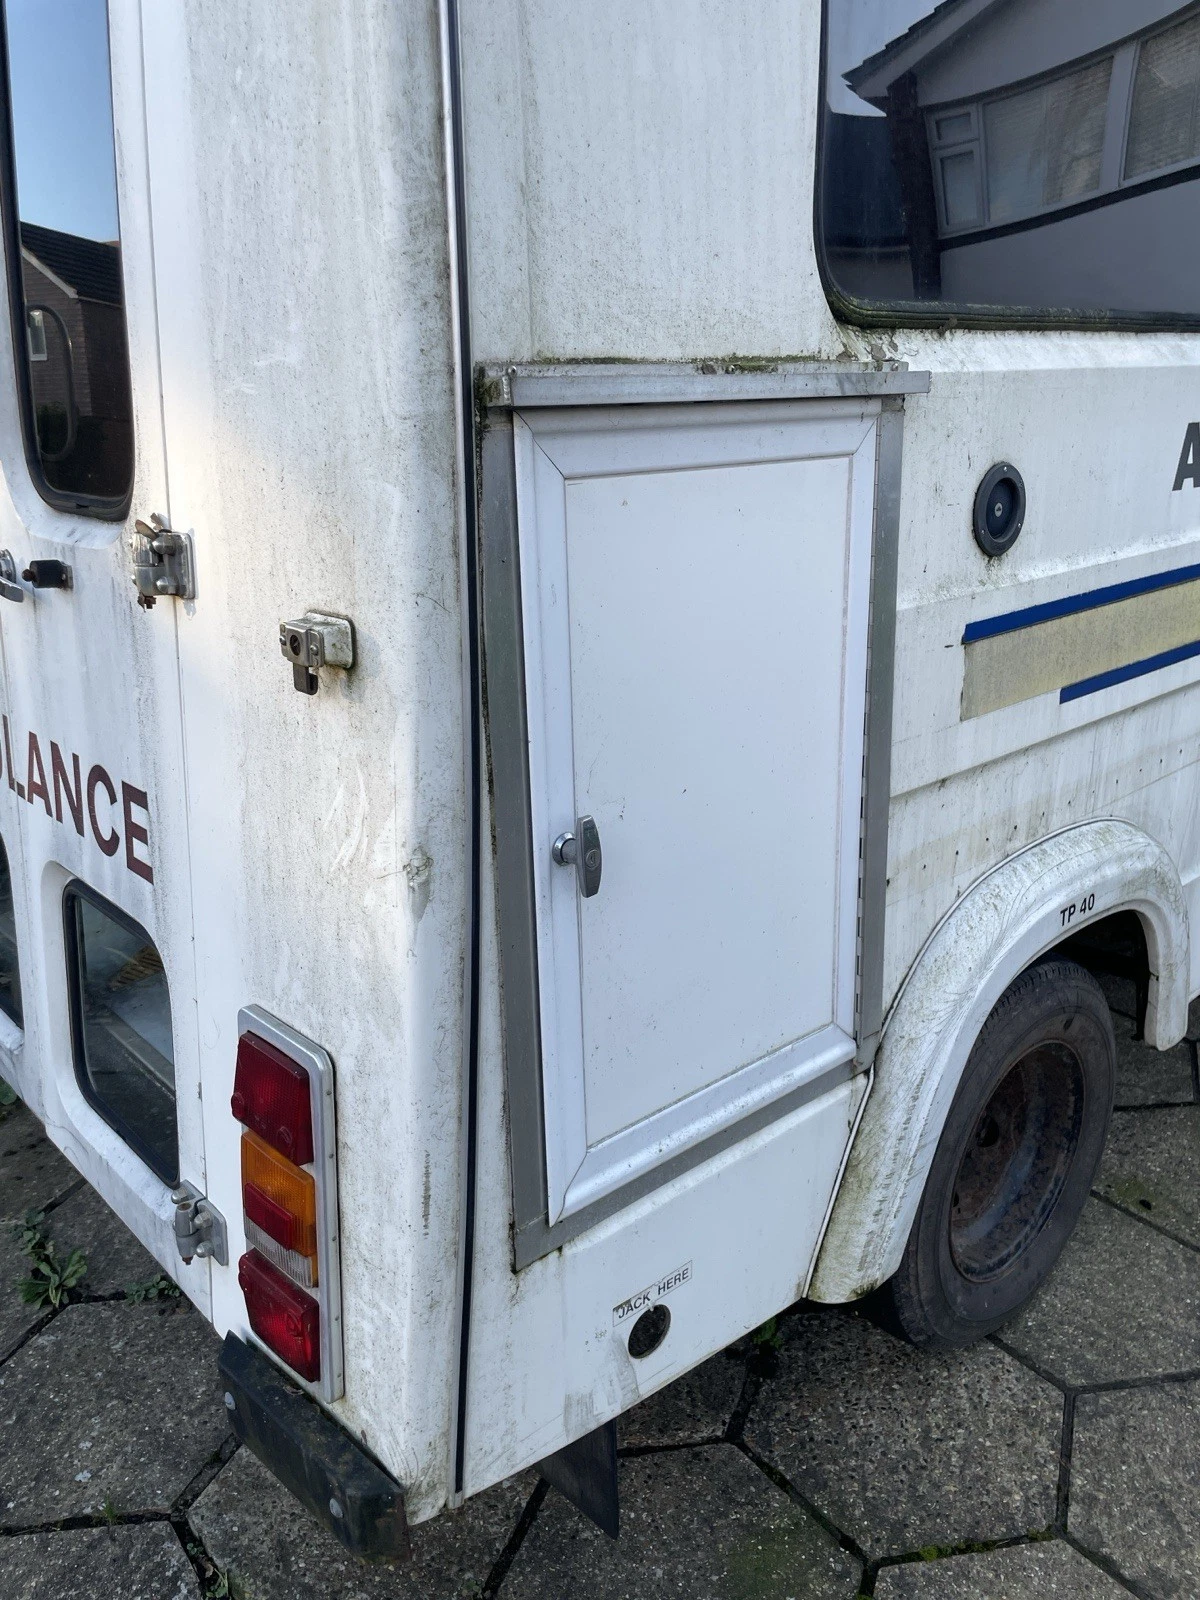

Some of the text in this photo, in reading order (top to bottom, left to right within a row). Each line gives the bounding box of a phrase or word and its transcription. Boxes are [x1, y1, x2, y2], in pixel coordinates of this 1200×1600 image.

[0, 714, 154, 885] LANCE
[1060, 893, 1095, 926] TP 40
[618, 1267, 689, 1319] JACK HERE
